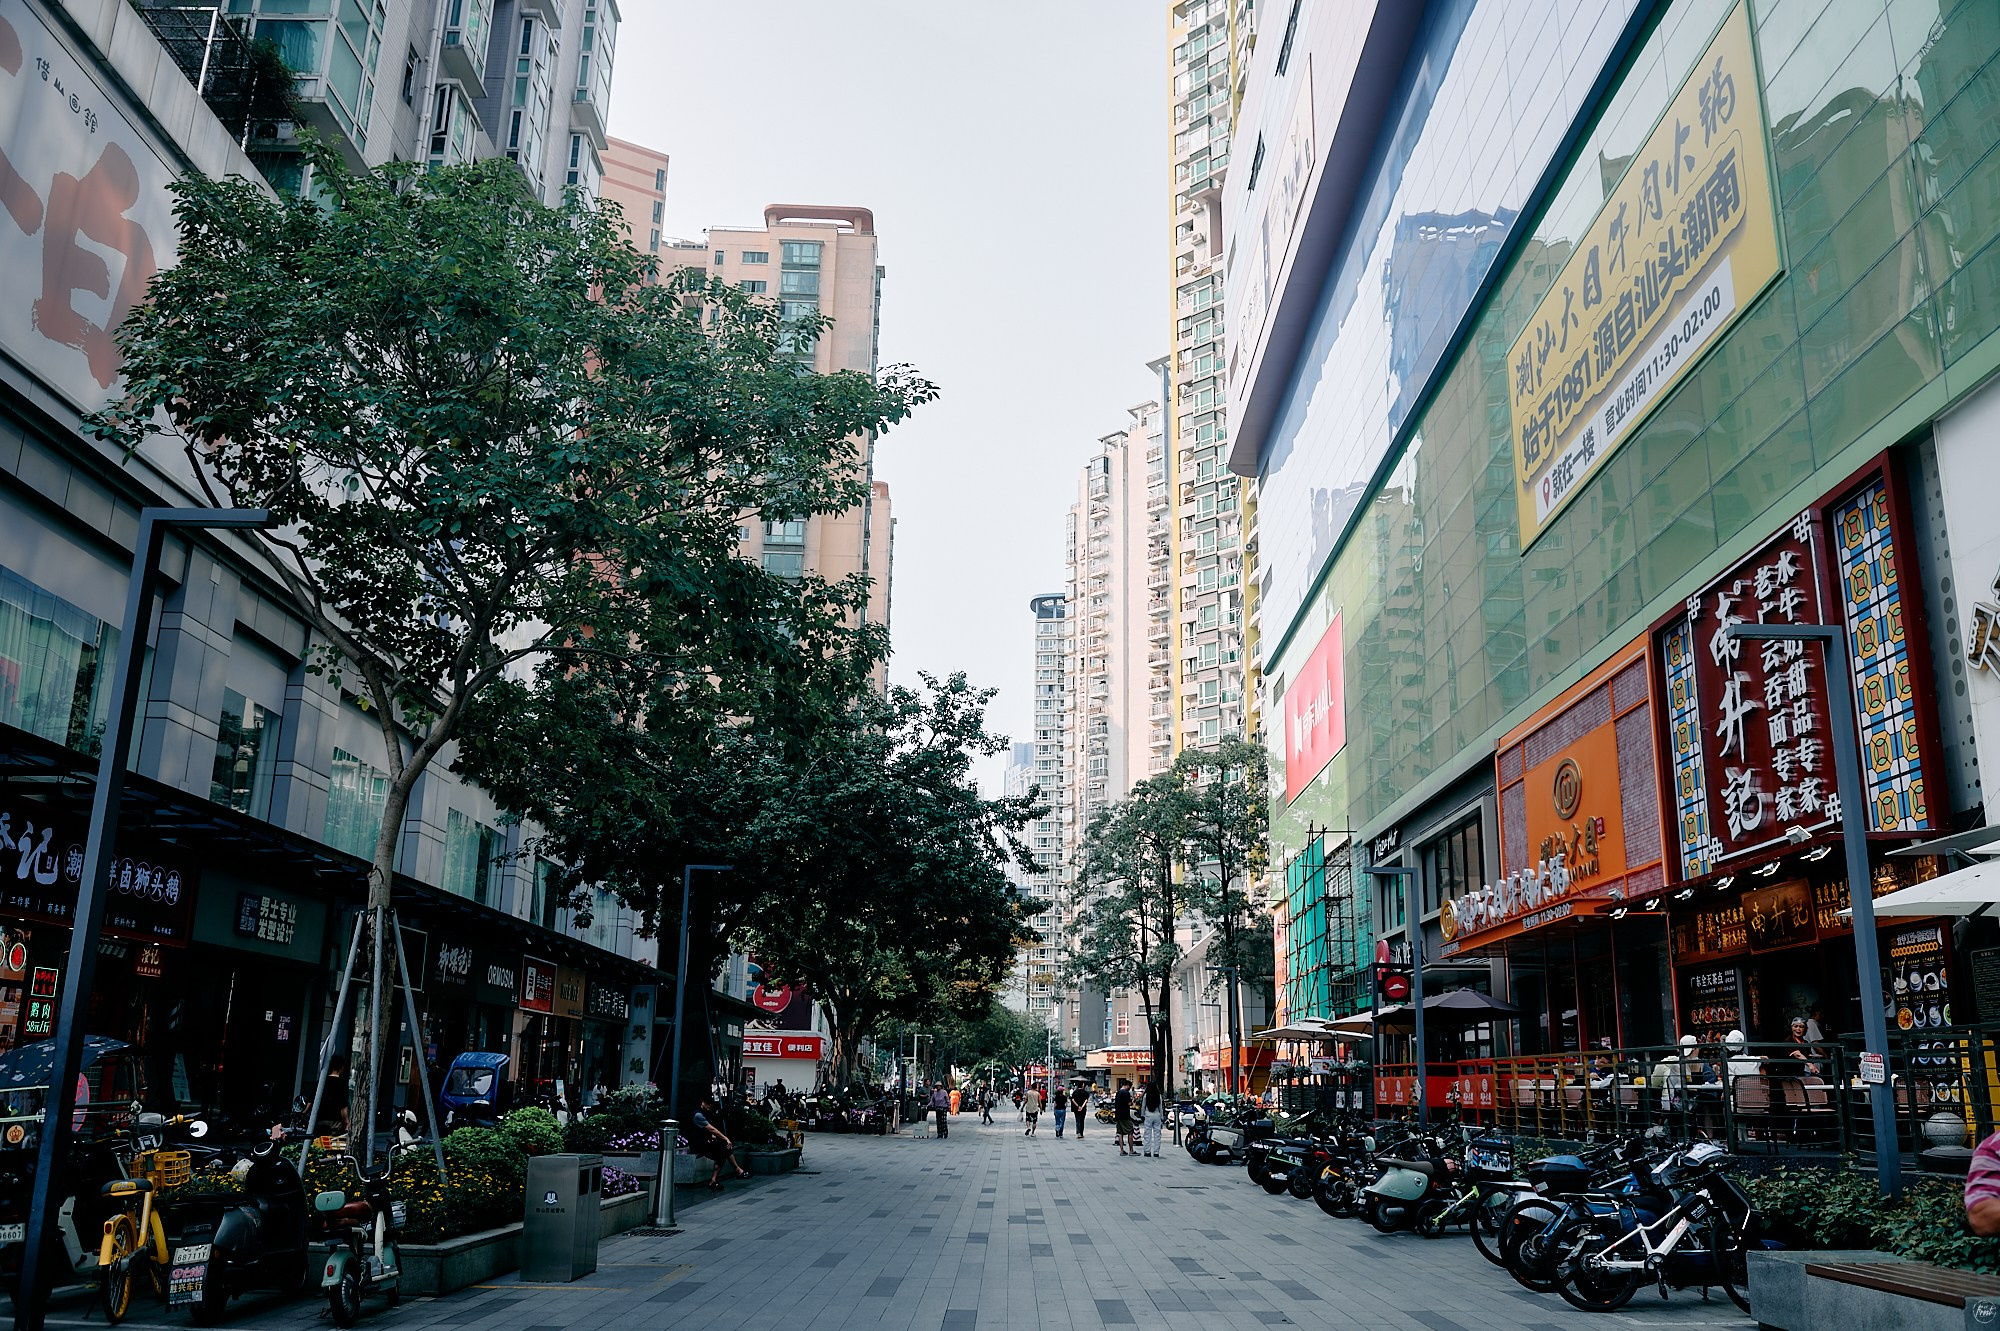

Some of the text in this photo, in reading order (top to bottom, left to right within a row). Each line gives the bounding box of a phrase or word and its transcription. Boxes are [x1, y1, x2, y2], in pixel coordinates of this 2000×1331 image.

[1515, 55, 1736, 406] 潮汕大目牛肉火锅
[1520, 147, 1741, 473] 始于1981 源自汕头潮南
[1551, 285, 1722, 501] 就在一楼 营业时间11:30-02:00
[257, 918, 295, 945] 发型设计
[259, 896, 297, 924] 男士专业
[629, 991, 650, 1074] 新天地
[787, 1043, 813, 1052] 便利店
[169, 1281, 203, 1294] 胜兴车行
